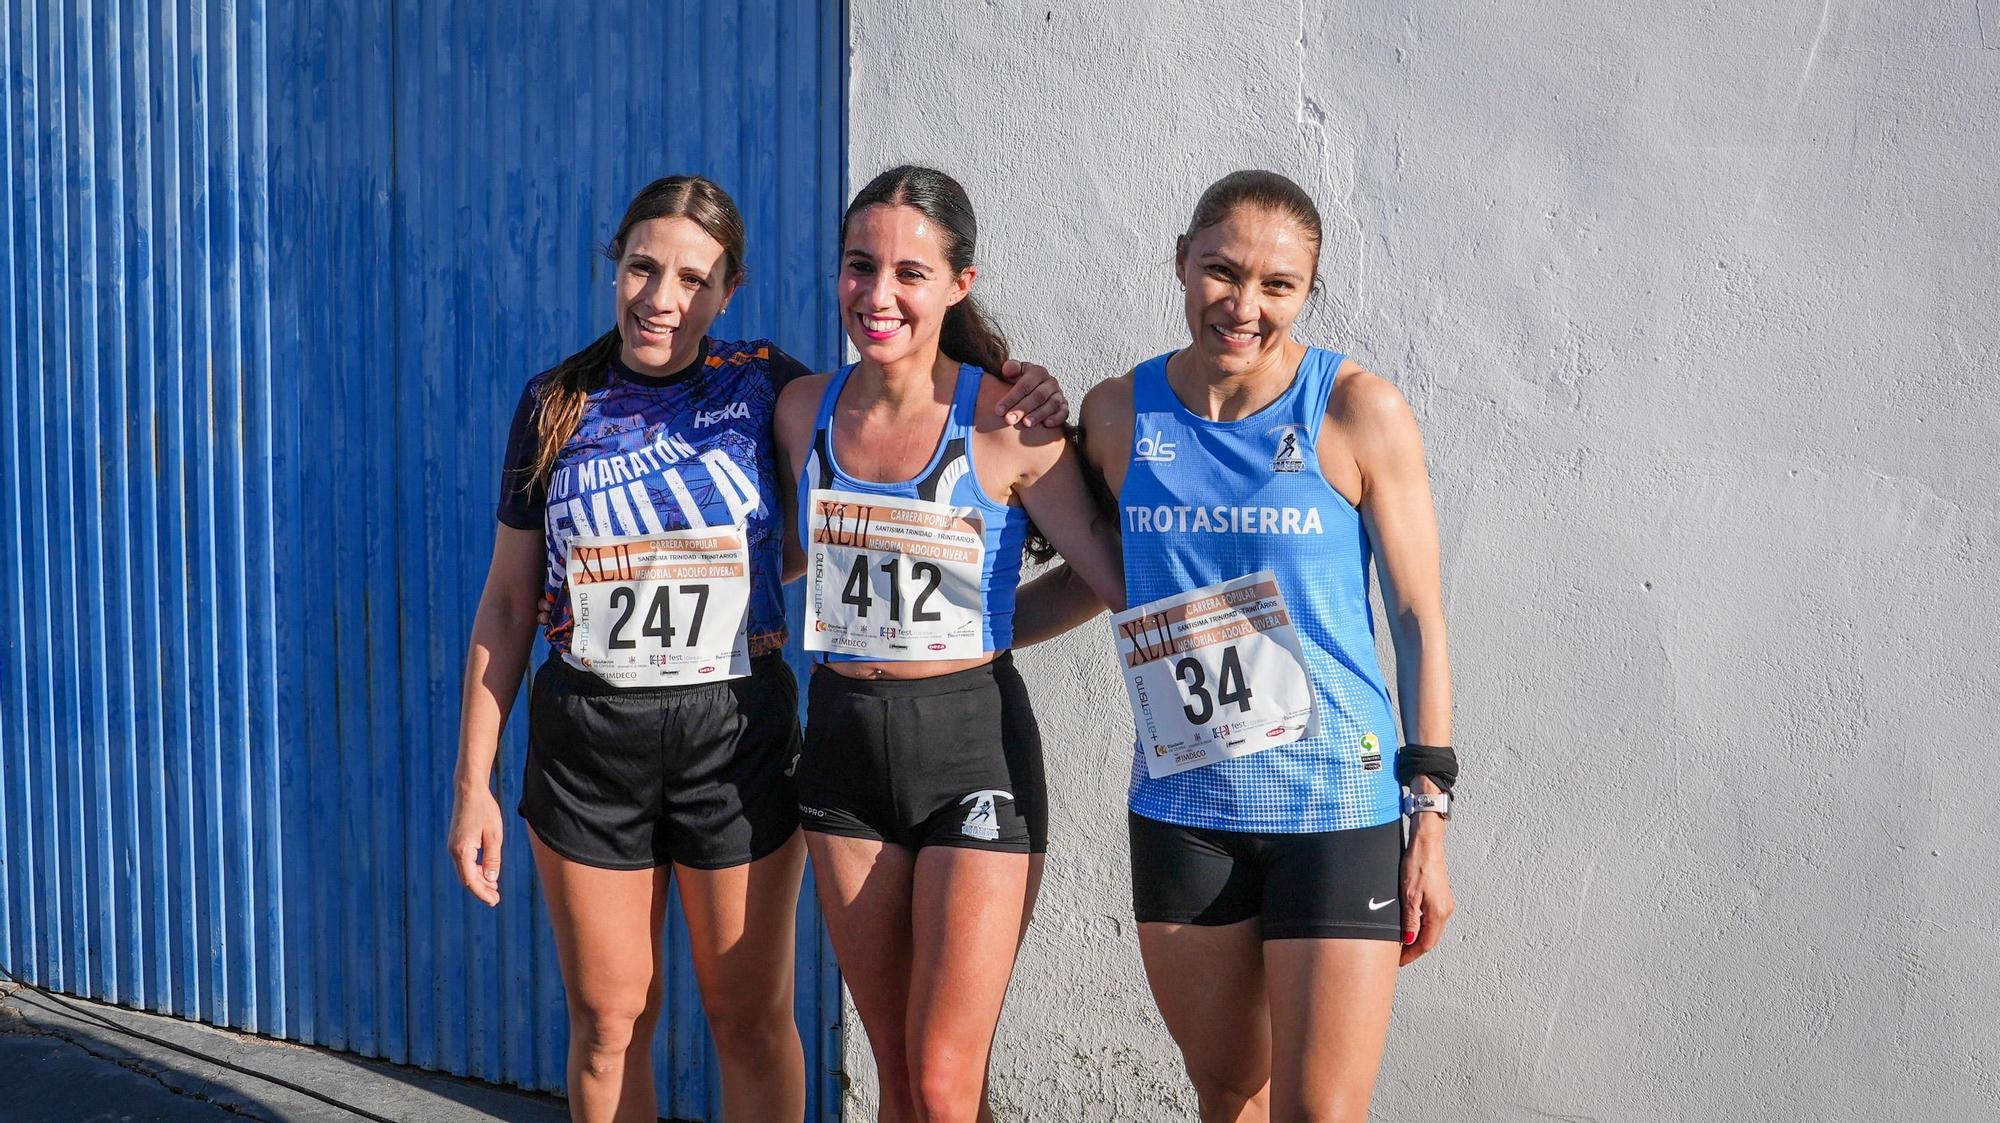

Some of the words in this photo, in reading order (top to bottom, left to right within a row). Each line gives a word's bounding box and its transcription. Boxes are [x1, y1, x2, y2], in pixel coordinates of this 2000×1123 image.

[694, 402, 750, 428] HOKA
[578, 432, 697, 493] MARATÓN
[816, 501, 873, 548] XLII
[890, 509, 923, 524] CARRERA
[925, 514, 958, 529] POPULAR
[1126, 506, 1323, 534] TROTASIERRA
[650, 540, 683, 549] CARRERA
[685, 538, 718, 549] POPULAR
[875, 525, 905, 534] SANTISIMA
[905, 528, 933, 538] TRINIDAD
[937, 533, 975, 543] TRINITARIOS
[575, 544, 634, 584] XLII
[868, 538, 904, 552] MEMORIAL
[906, 543, 941, 558] "ADOLFO
[942, 548, 972, 562] RIVERA"
[635, 567, 672, 579] MEMORIAL
[673, 567, 707, 578] "ADOLFO
[709, 566, 738, 577] RIVERA"
[842, 554, 941, 622] 412
[1186, 598, 1221, 615] CARRERA
[1222, 587, 1256, 605] POPULAR
[609, 585, 709, 649] 247
[1177, 618, 1209, 632] SANTISIMA
[1210, 610, 1237, 623] TRINIDAD
[1242, 601, 1277, 614] TRINITARIOS
[839, 638, 867, 648] IMDECO
[1122, 611, 1177, 667] XLII
[1178, 632, 1217, 651] MEMORIAL
[1218, 622, 1253, 640] "ADOLFO
[1253, 614, 1282, 632] RIVERA"
[1176, 646, 1252, 726] 34
[1181, 750, 1206, 762] IMDECO
